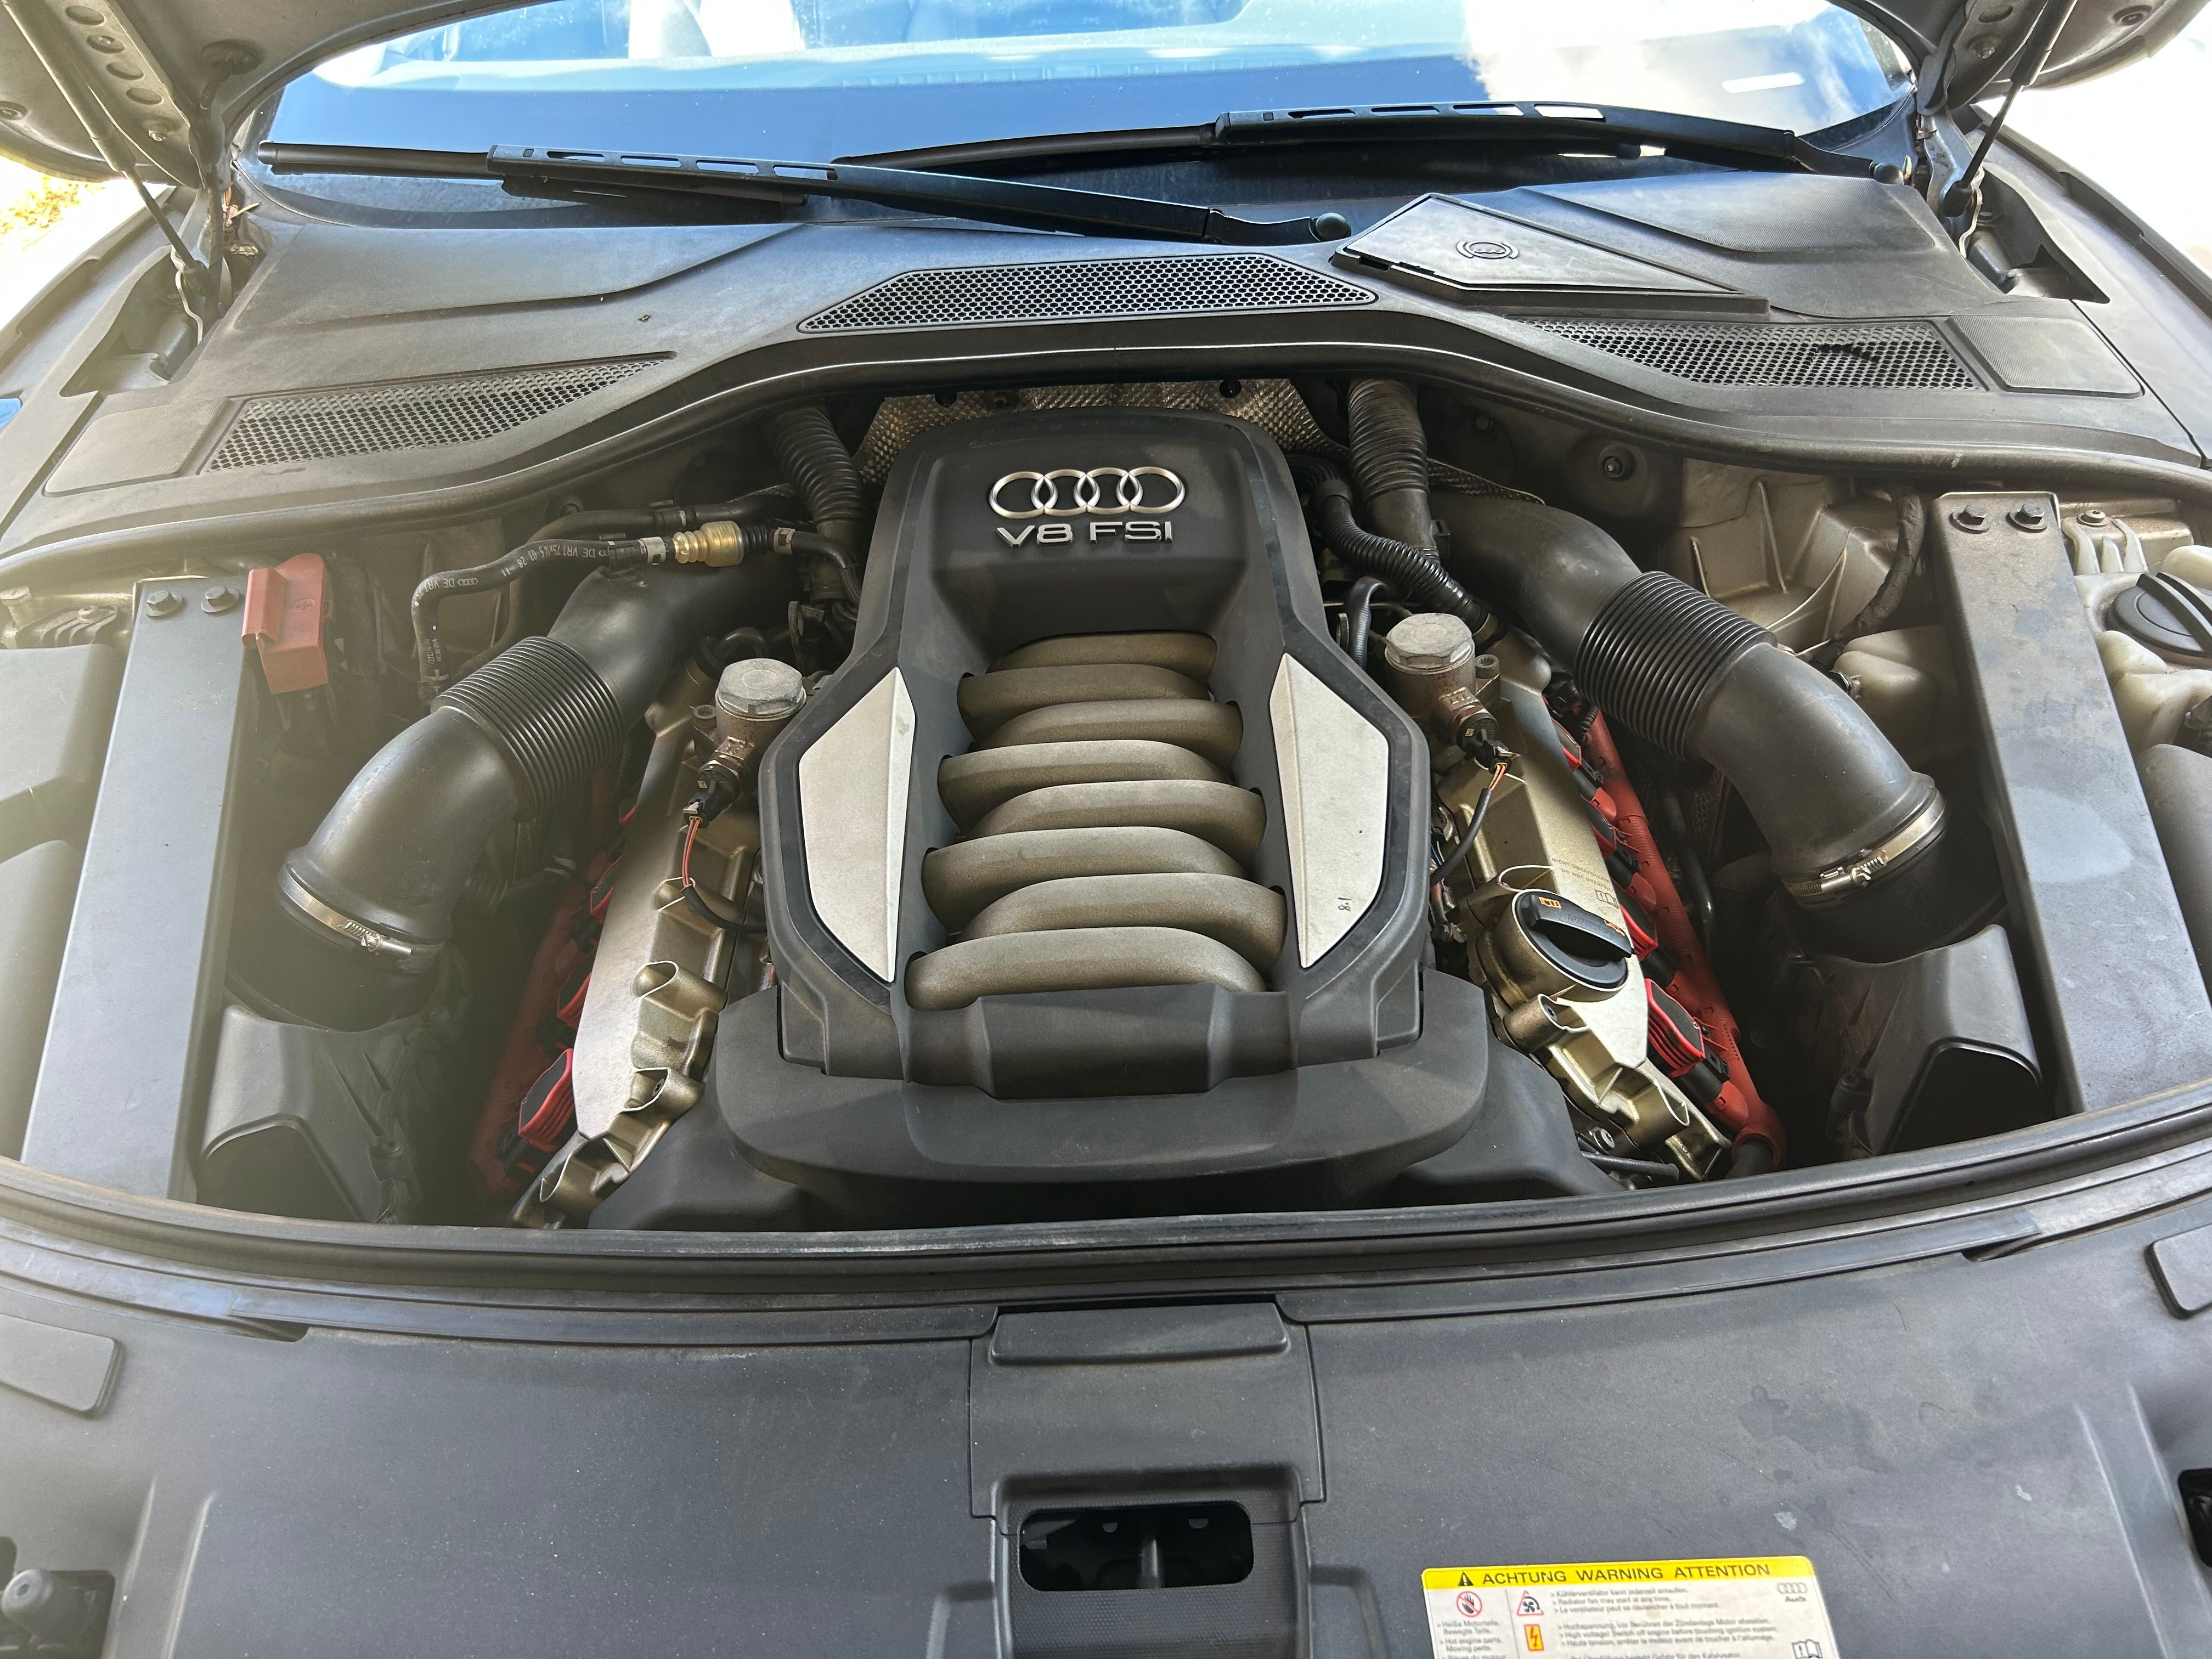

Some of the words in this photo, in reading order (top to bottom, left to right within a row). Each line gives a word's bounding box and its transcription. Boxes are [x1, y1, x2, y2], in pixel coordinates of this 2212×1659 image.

[997, 523, 1073, 549] V8
[1088, 521, 1173, 544] FSI
[1567, 913, 1601, 933] Castrol
[1482, 1571, 1567, 1584] ACHTUNG
[1575, 1567, 1664, 1581] WARNING
[1674, 1564, 1771, 1578] ATTENTION
